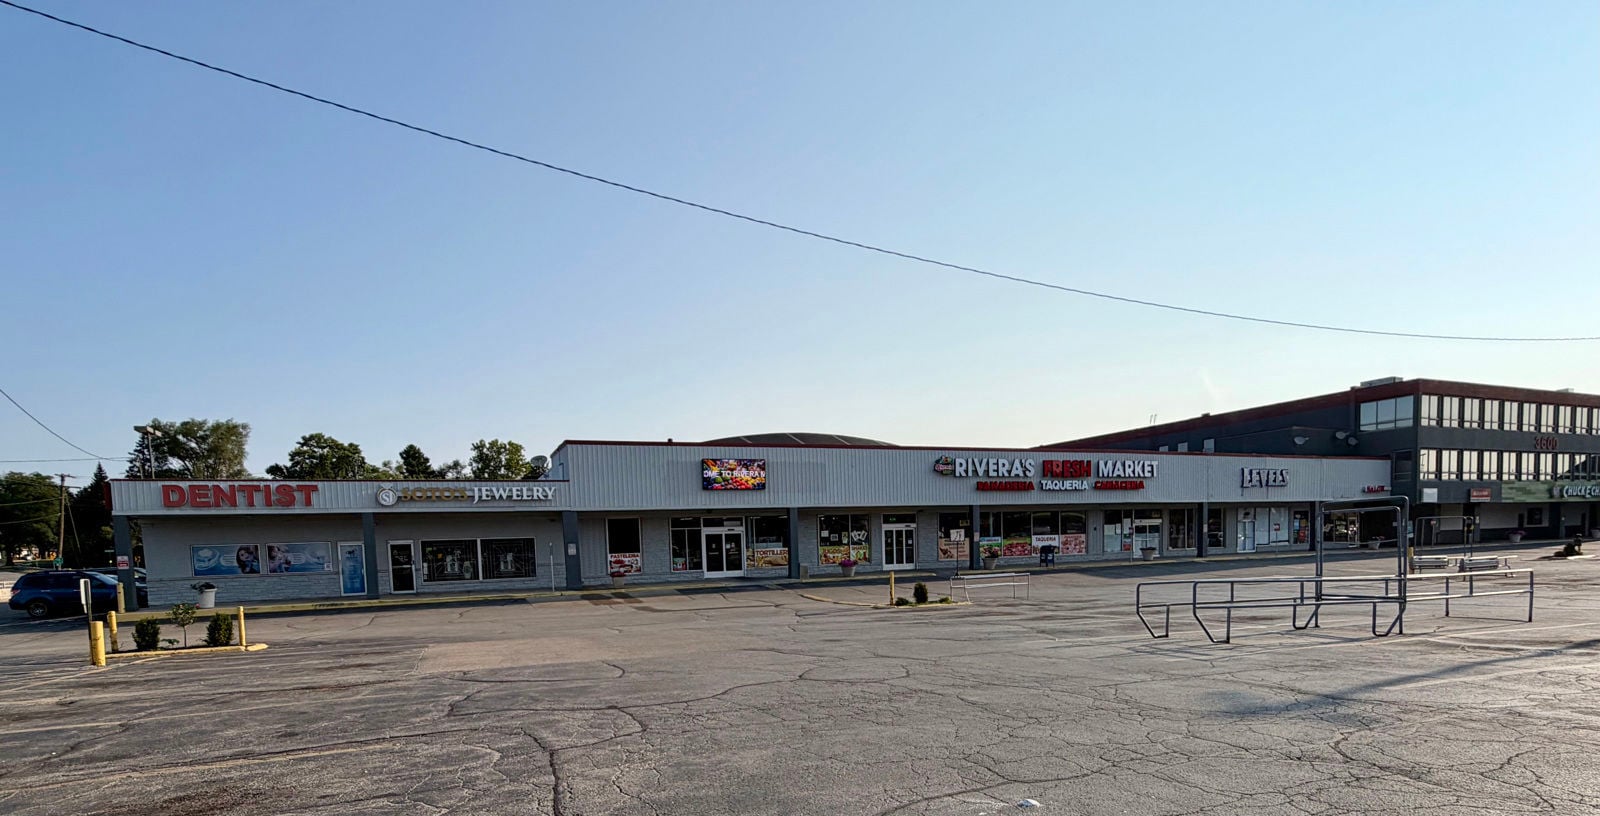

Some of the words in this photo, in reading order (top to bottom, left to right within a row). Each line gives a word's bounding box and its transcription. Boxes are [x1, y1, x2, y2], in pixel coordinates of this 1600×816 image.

[1535, 437, 1559, 450] 3600
[721, 470, 731, 478] TO
[733, 470, 759, 478] RIVERA
[954, 457, 1035, 478] RIVERA'S
[1042, 459, 1091, 478] FRESH
[1097, 459, 1158, 478] MARKET
[1040, 479, 1088, 491] TAQUERIA
[1563, 485, 1585, 498] CHUCK
[160, 484, 319, 508] DENTIST
[472, 486, 555, 504] JEWELRY
